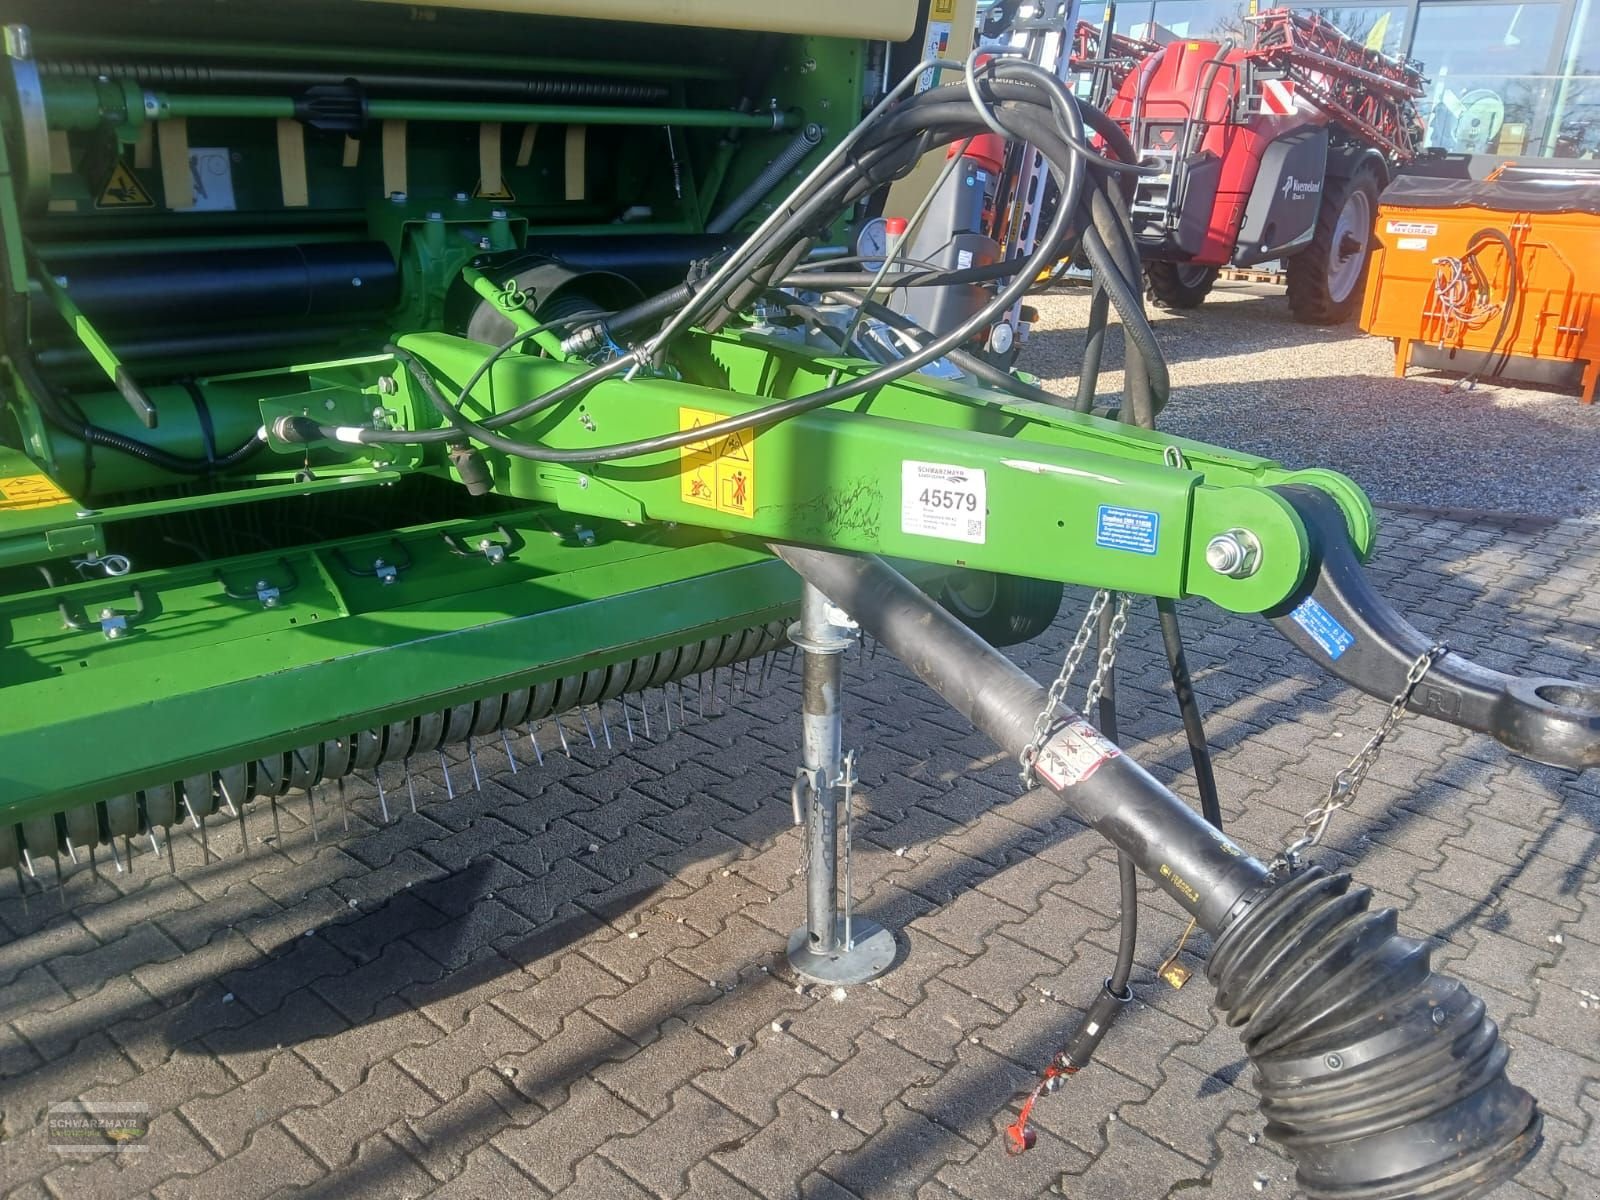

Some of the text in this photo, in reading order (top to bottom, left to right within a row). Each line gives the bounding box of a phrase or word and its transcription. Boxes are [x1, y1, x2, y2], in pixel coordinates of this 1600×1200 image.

[996, 78, 1037, 88] MUELLER
[1393, 226, 1434, 235] HYDRAC
[917, 465, 965, 476] SCHWARZMAYR
[919, 487, 977, 512] 45579
